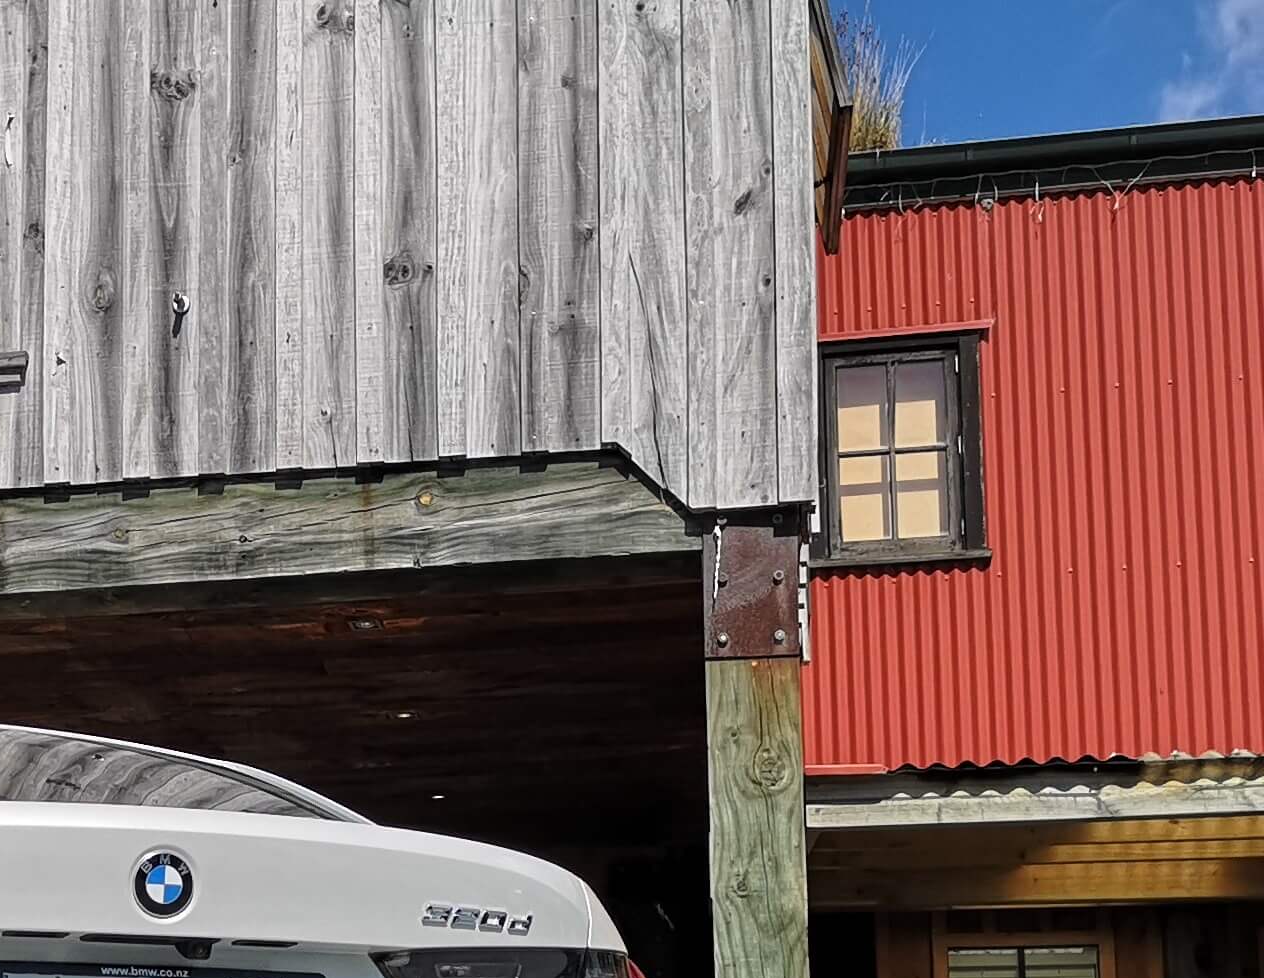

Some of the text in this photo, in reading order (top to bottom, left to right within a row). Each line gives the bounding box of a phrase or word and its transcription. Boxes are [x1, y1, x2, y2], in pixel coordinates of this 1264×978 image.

[140, 854, 189, 876] BMW
[421, 904, 533, 936] 320d
[100, 966, 190, 978] www.bmw.co.nz
